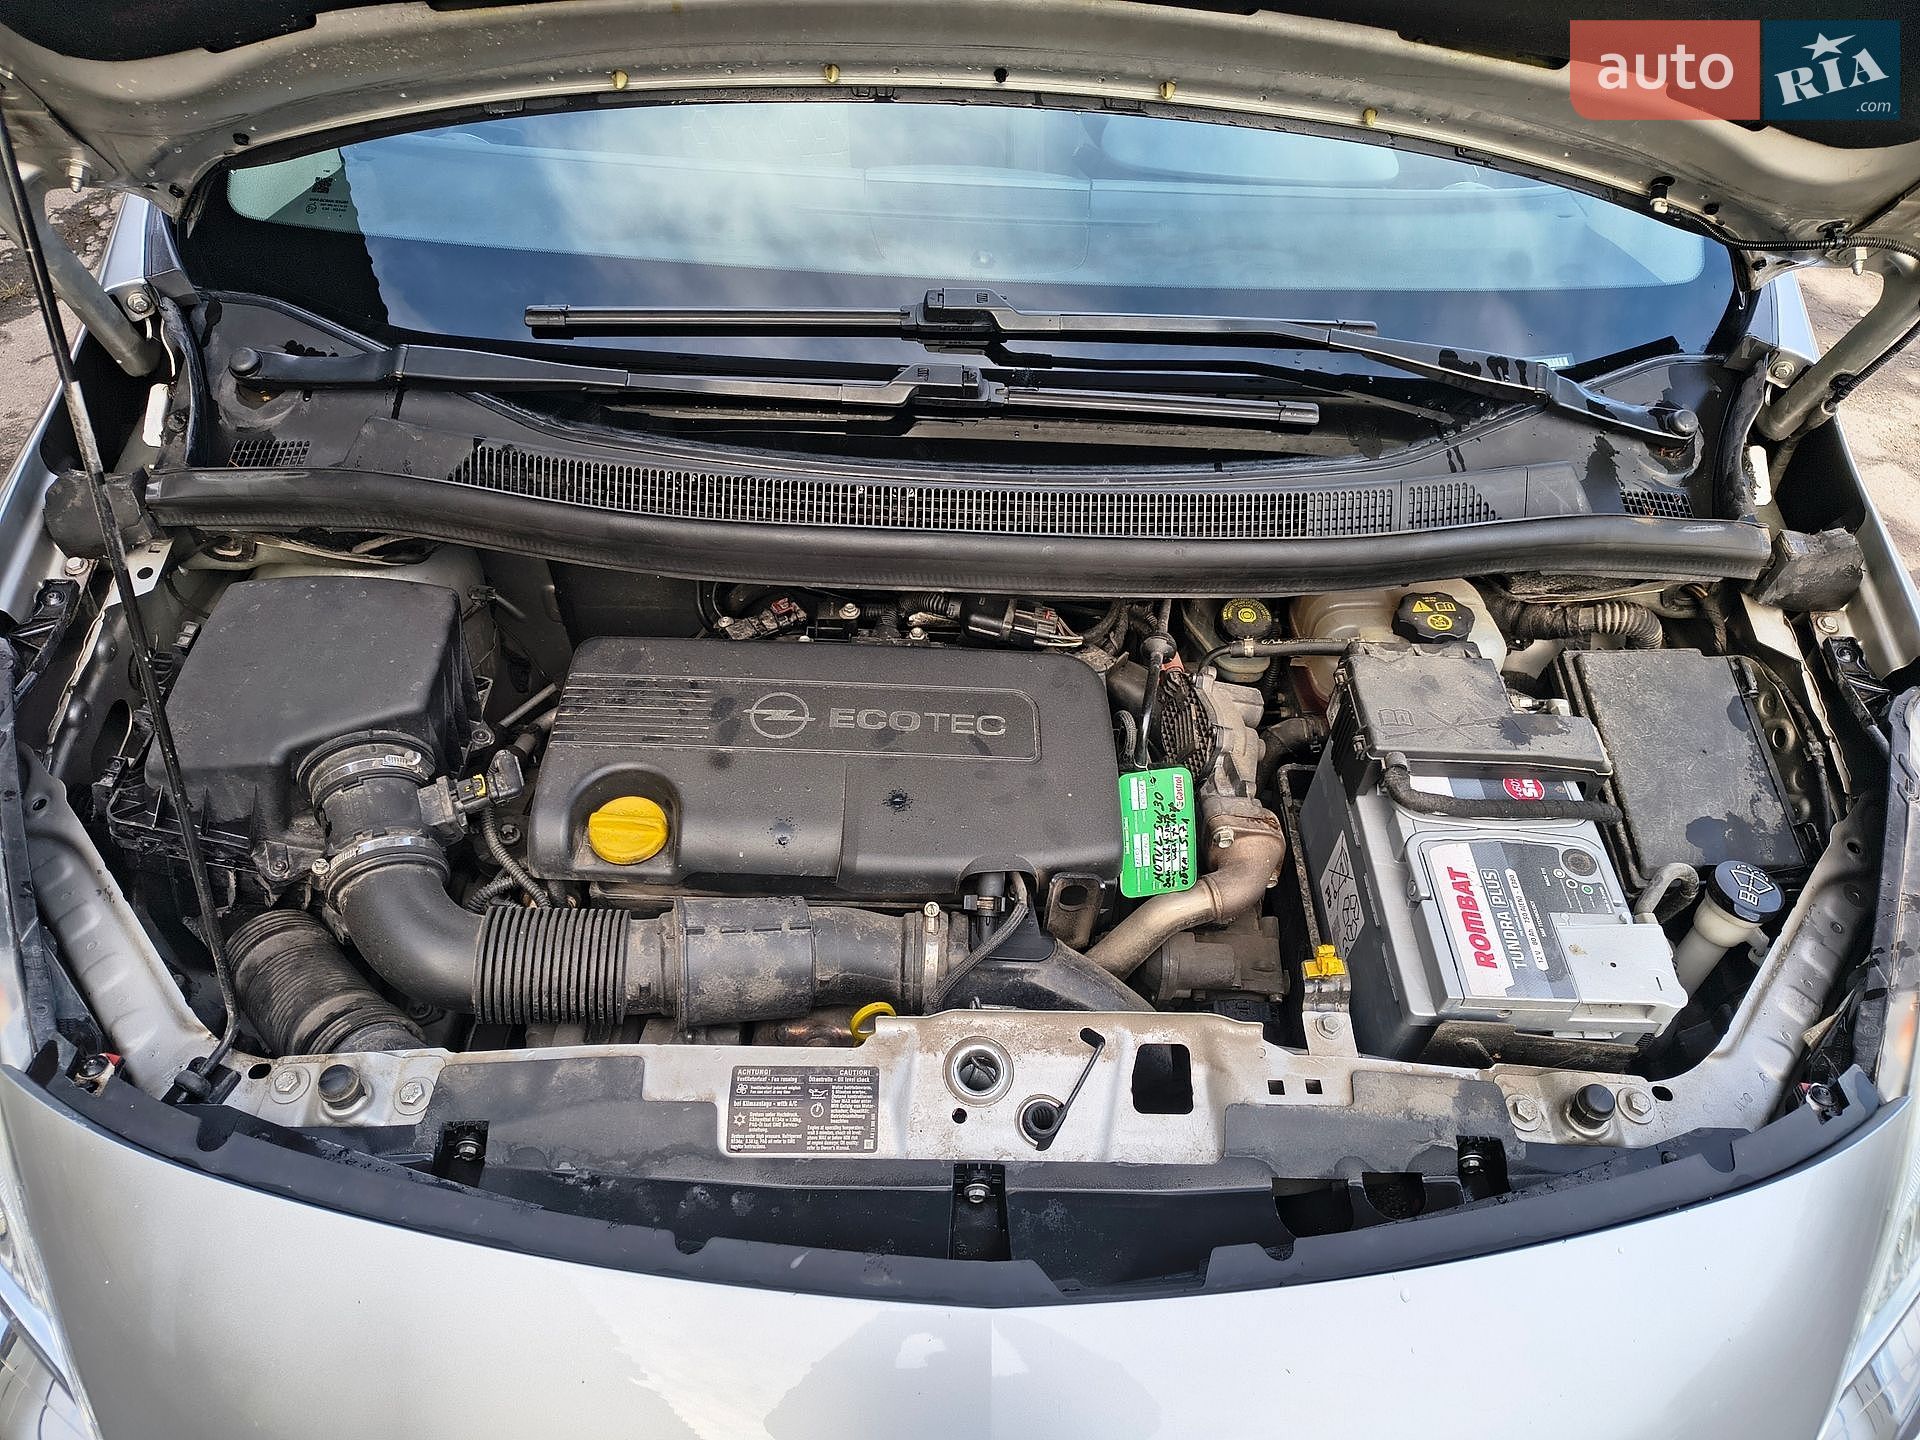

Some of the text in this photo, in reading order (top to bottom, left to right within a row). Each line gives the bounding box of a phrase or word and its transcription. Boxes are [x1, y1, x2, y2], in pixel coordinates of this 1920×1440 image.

[829, 707, 1007, 736] ECOTEC
[1175, 776, 1184, 801] Castrol
[1483, 871, 1507, 905] PLUS
[1447, 866, 1498, 969] ROMBAT
[1497, 911, 1527, 970] TUNDRA
